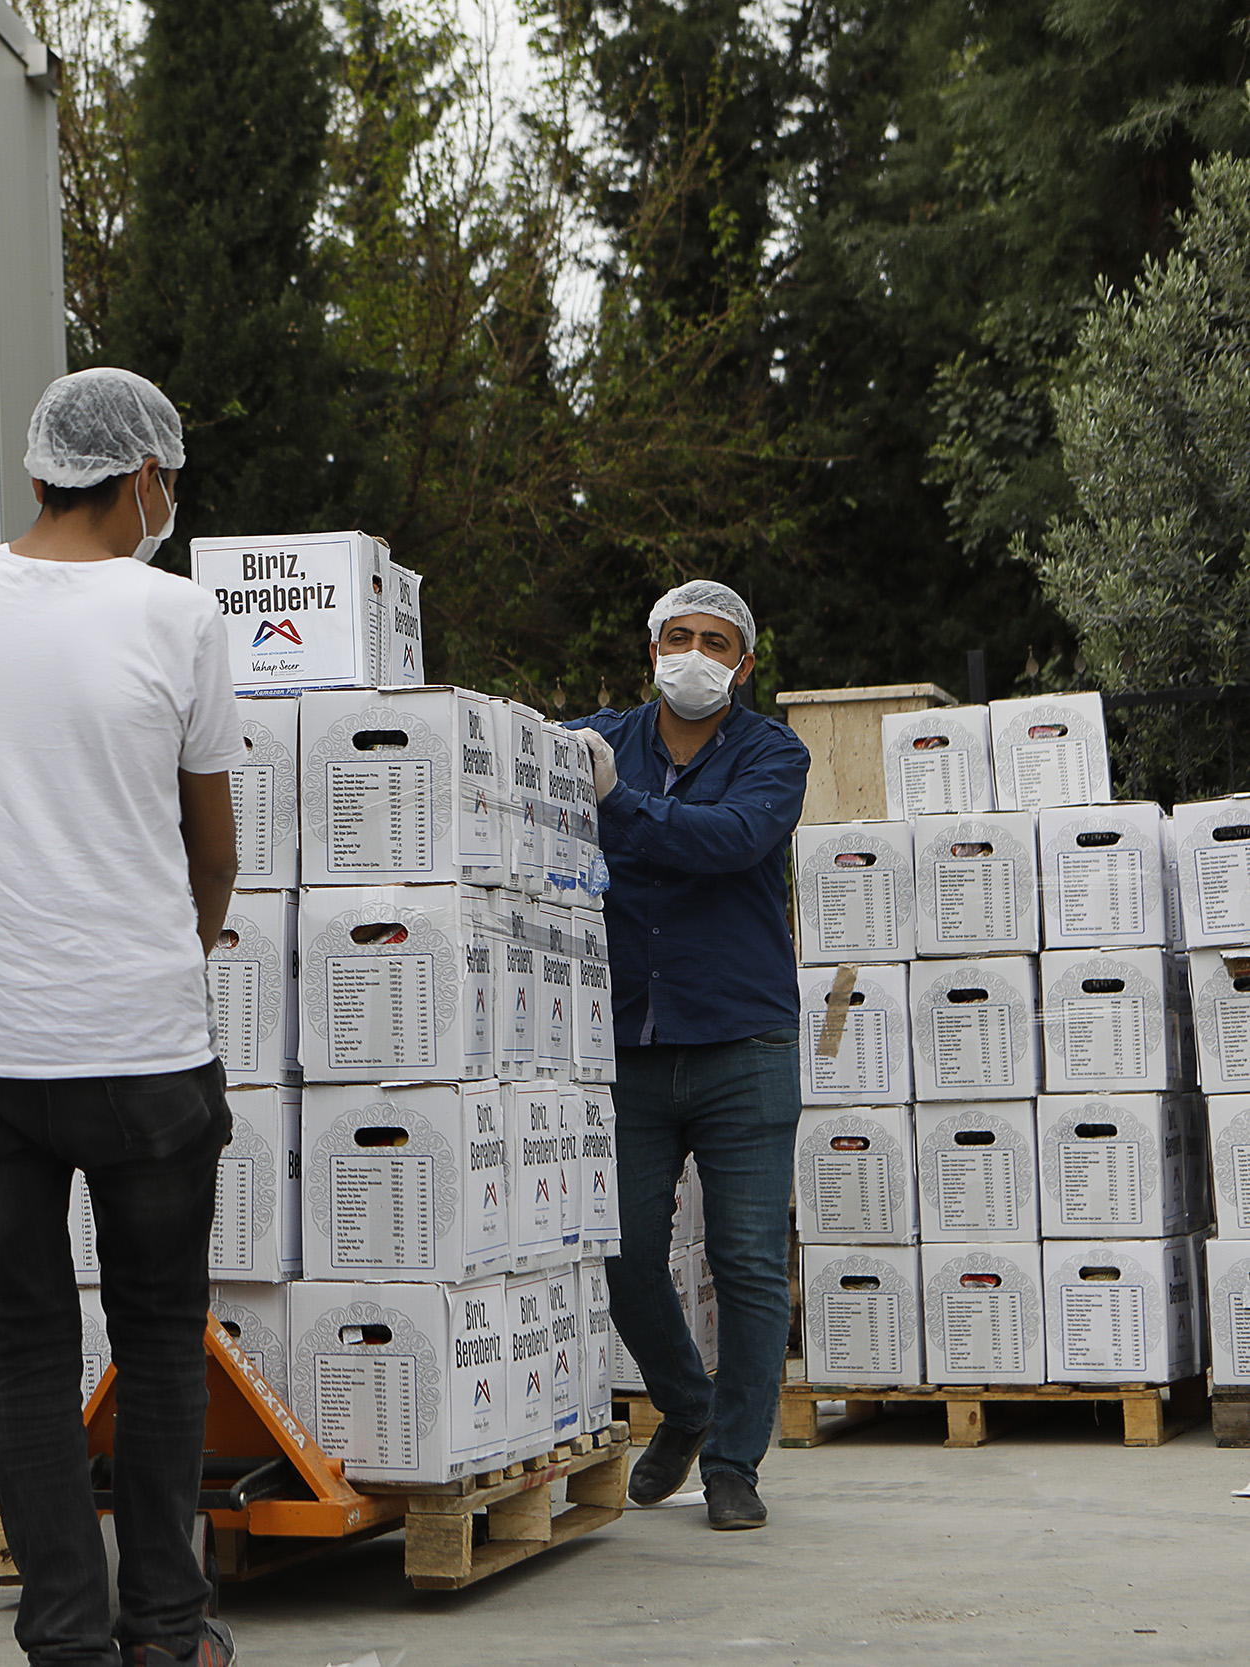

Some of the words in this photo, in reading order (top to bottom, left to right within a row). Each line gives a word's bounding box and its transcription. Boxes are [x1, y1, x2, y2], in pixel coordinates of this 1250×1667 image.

[242, 551, 306, 581] Biriz,
[215, 581, 336, 616] Beraberiz
[395, 606, 420, 640] Beraberiz
[252, 660, 277, 676] Vahap
[468, 709, 486, 745] Biriz,
[461, 743, 494, 777] Beraberiz
[553, 738, 571, 774] Biriz,
[514, 755, 542, 792] Beraberiz
[548, 768, 576, 804] Beraberiz
[577, 776, 597, 808] eraberiz
[507, 944, 533, 974] Beraberiz
[544, 955, 571, 987] Beraberiz
[580, 959, 608, 989] Beraberiz
[477, 1103, 496, 1134] Biriz,
[530, 1102, 550, 1133] Biriz,
[471, 1137, 504, 1171] Beraberiz
[522, 1135, 559, 1167] Beraberiz
[465, 1298, 491, 1331] Biriz,
[519, 1293, 541, 1326] Biriz,
[455, 1332, 502, 1369] Beraberiz
[512, 1323, 550, 1362] Beraberiz
[216, 1329, 305, 1449] MAX-EXTRA
